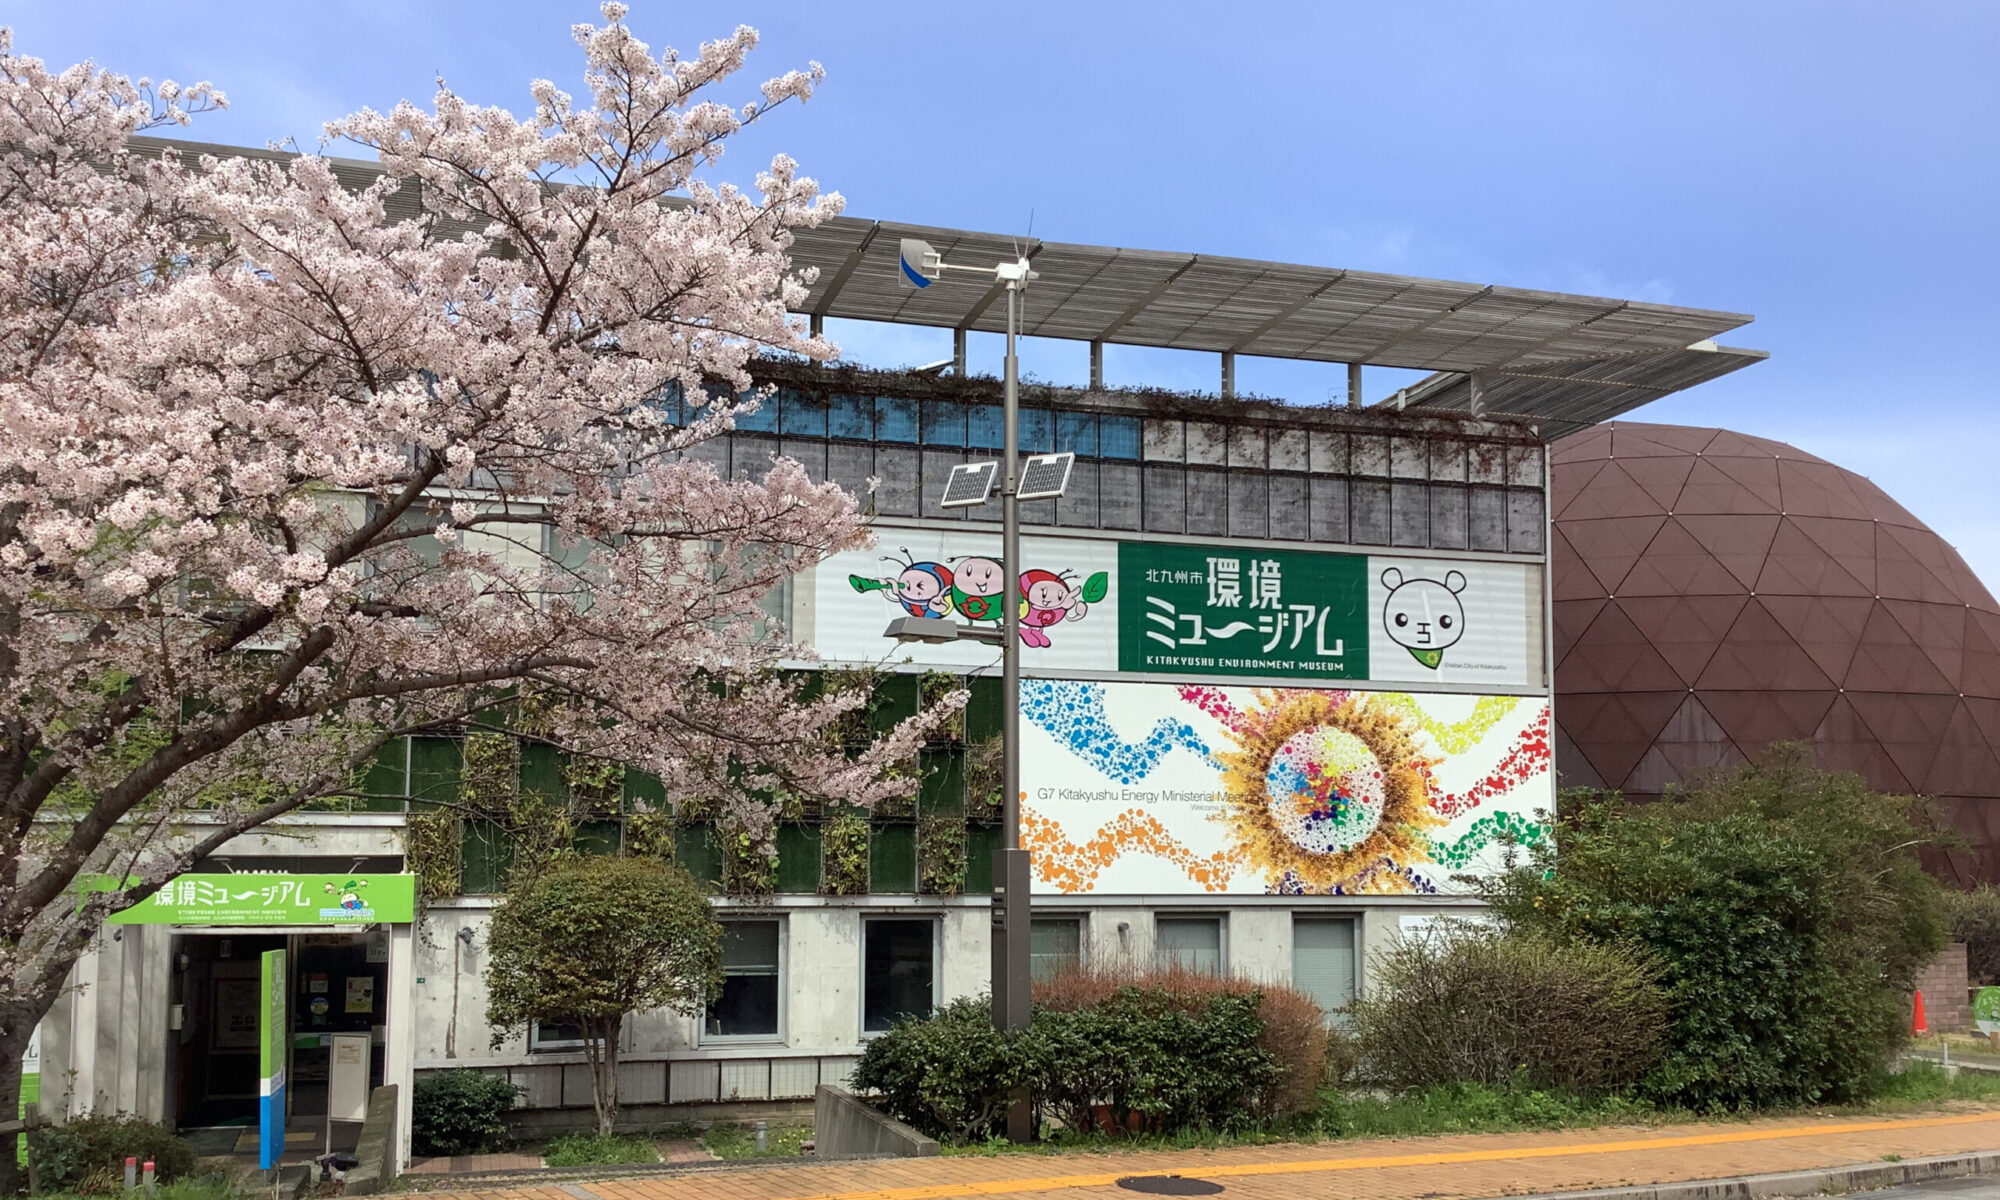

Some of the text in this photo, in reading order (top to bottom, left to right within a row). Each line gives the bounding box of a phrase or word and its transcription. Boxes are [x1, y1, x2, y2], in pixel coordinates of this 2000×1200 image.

[1146, 557, 1283, 609] 北九州市 環境
[1146, 596, 1344, 656] ミュージアム
[1147, 655, 1344, 671] KITAKYUSHU ENVIRONMENT MUSEUM
[1037, 788, 1054, 800] G7
[1059, 788, 1118, 803] Kitakyushu
[1122, 789, 1159, 804] Energy
[1162, 790, 1214, 802] Ministerial
